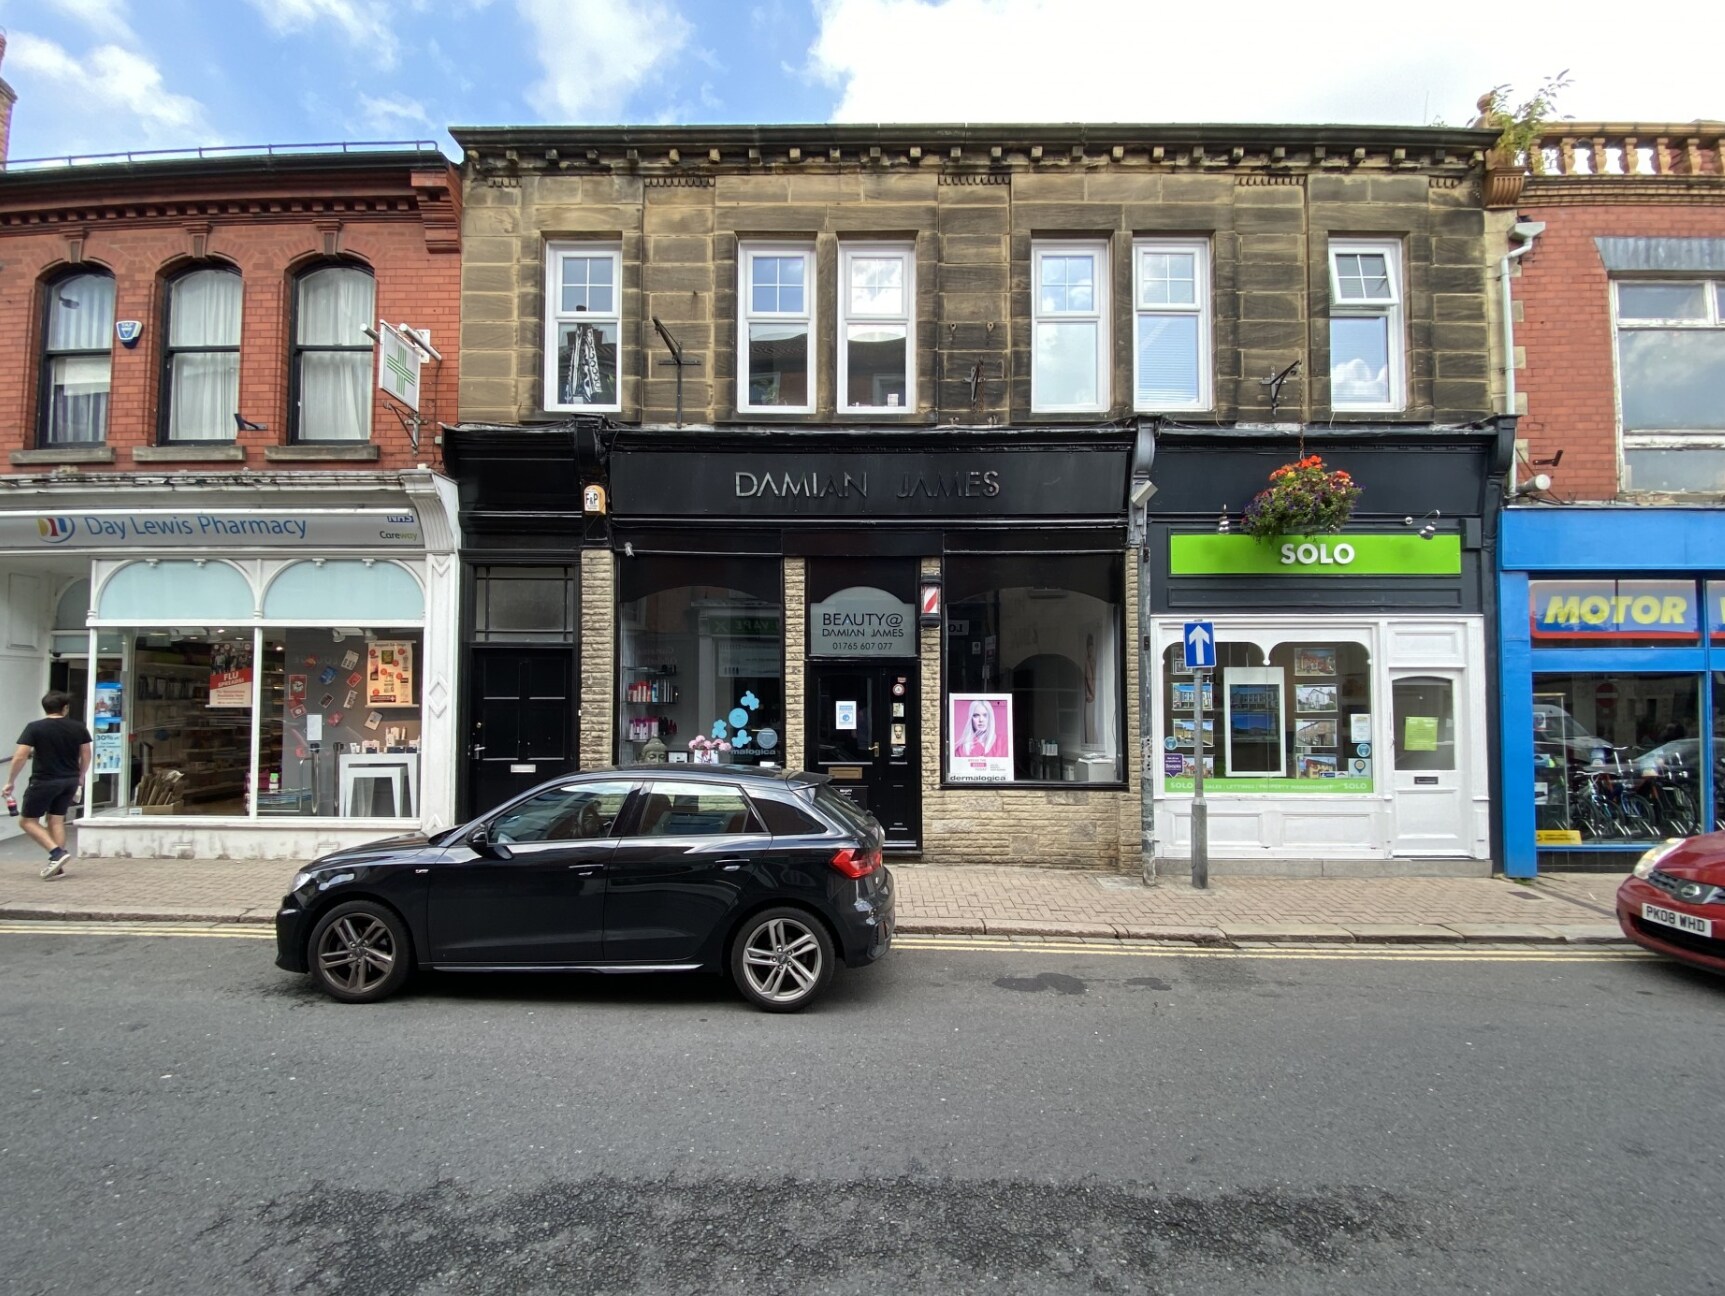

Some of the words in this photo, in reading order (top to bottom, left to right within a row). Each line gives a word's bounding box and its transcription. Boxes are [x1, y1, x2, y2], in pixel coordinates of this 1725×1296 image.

[735, 471, 867, 497] DAMIAN
[897, 471, 1000, 497] JAMES
[585, 492, 598, 504] F&P
[84, 516, 126, 540] Day
[130, 516, 193, 535] Lewis
[197, 515, 307, 539] Pharmacy
[379, 530, 418, 541] Careway
[1281, 543, 1355, 565] SOLO
[1543, 595, 1687, 625] MOTOR
[823, 613, 904, 628] BEAUTY@
[822, 628, 865, 638] DAMIAN
[871, 628, 905, 638] JAMES
[832, 642, 859, 651] 01765
[860, 642, 877, 651] 607
[877, 642, 893, 651] 077
[223, 671, 239, 681] FLU
[949, 774, 1006, 783] dermalogica
[1170, 781, 1194, 789] SOLO
[1646, 905, 1676, 925] PK08
[1679, 914, 1706, 933] WHD
